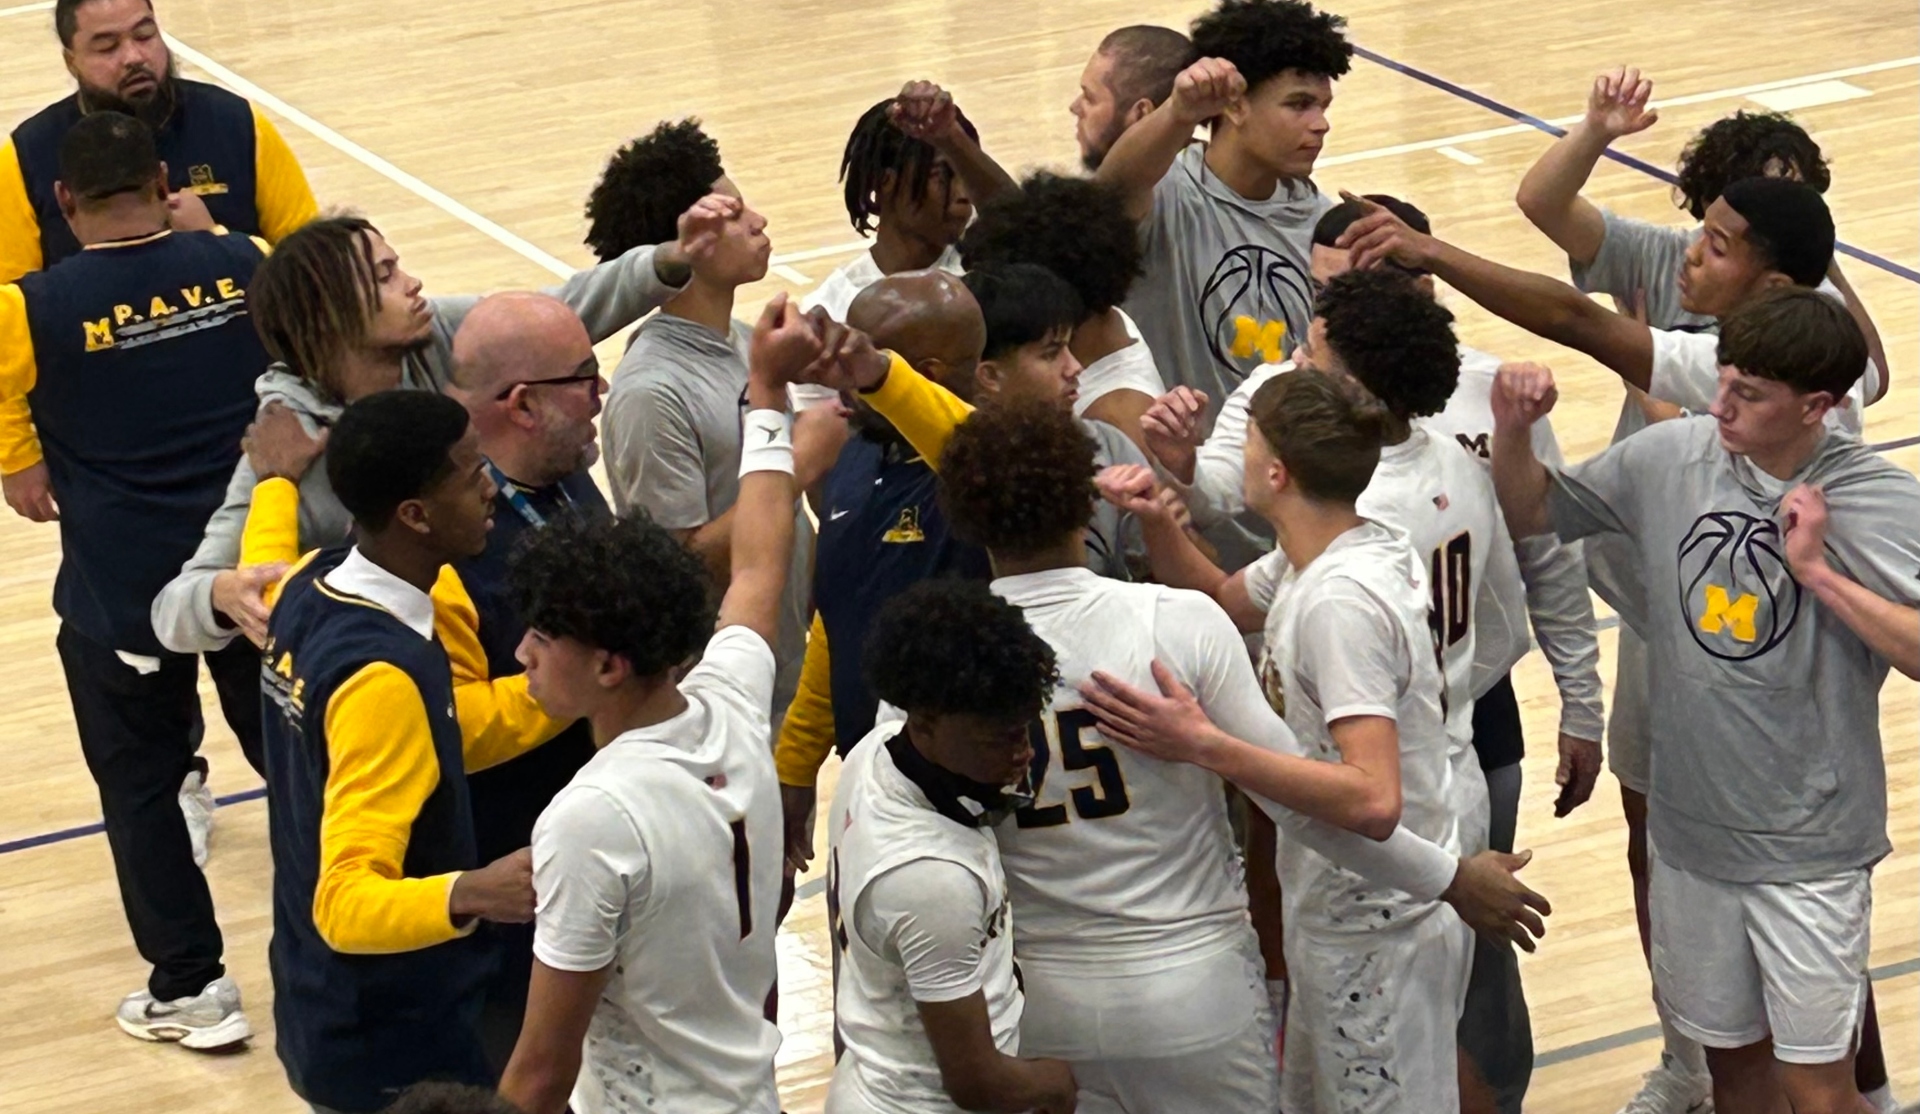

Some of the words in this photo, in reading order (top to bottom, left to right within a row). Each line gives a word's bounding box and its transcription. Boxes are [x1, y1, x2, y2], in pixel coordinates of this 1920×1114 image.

[83, 317, 115, 352] M
[1234, 314, 1287, 364] M
[1698, 584, 1759, 643] M
